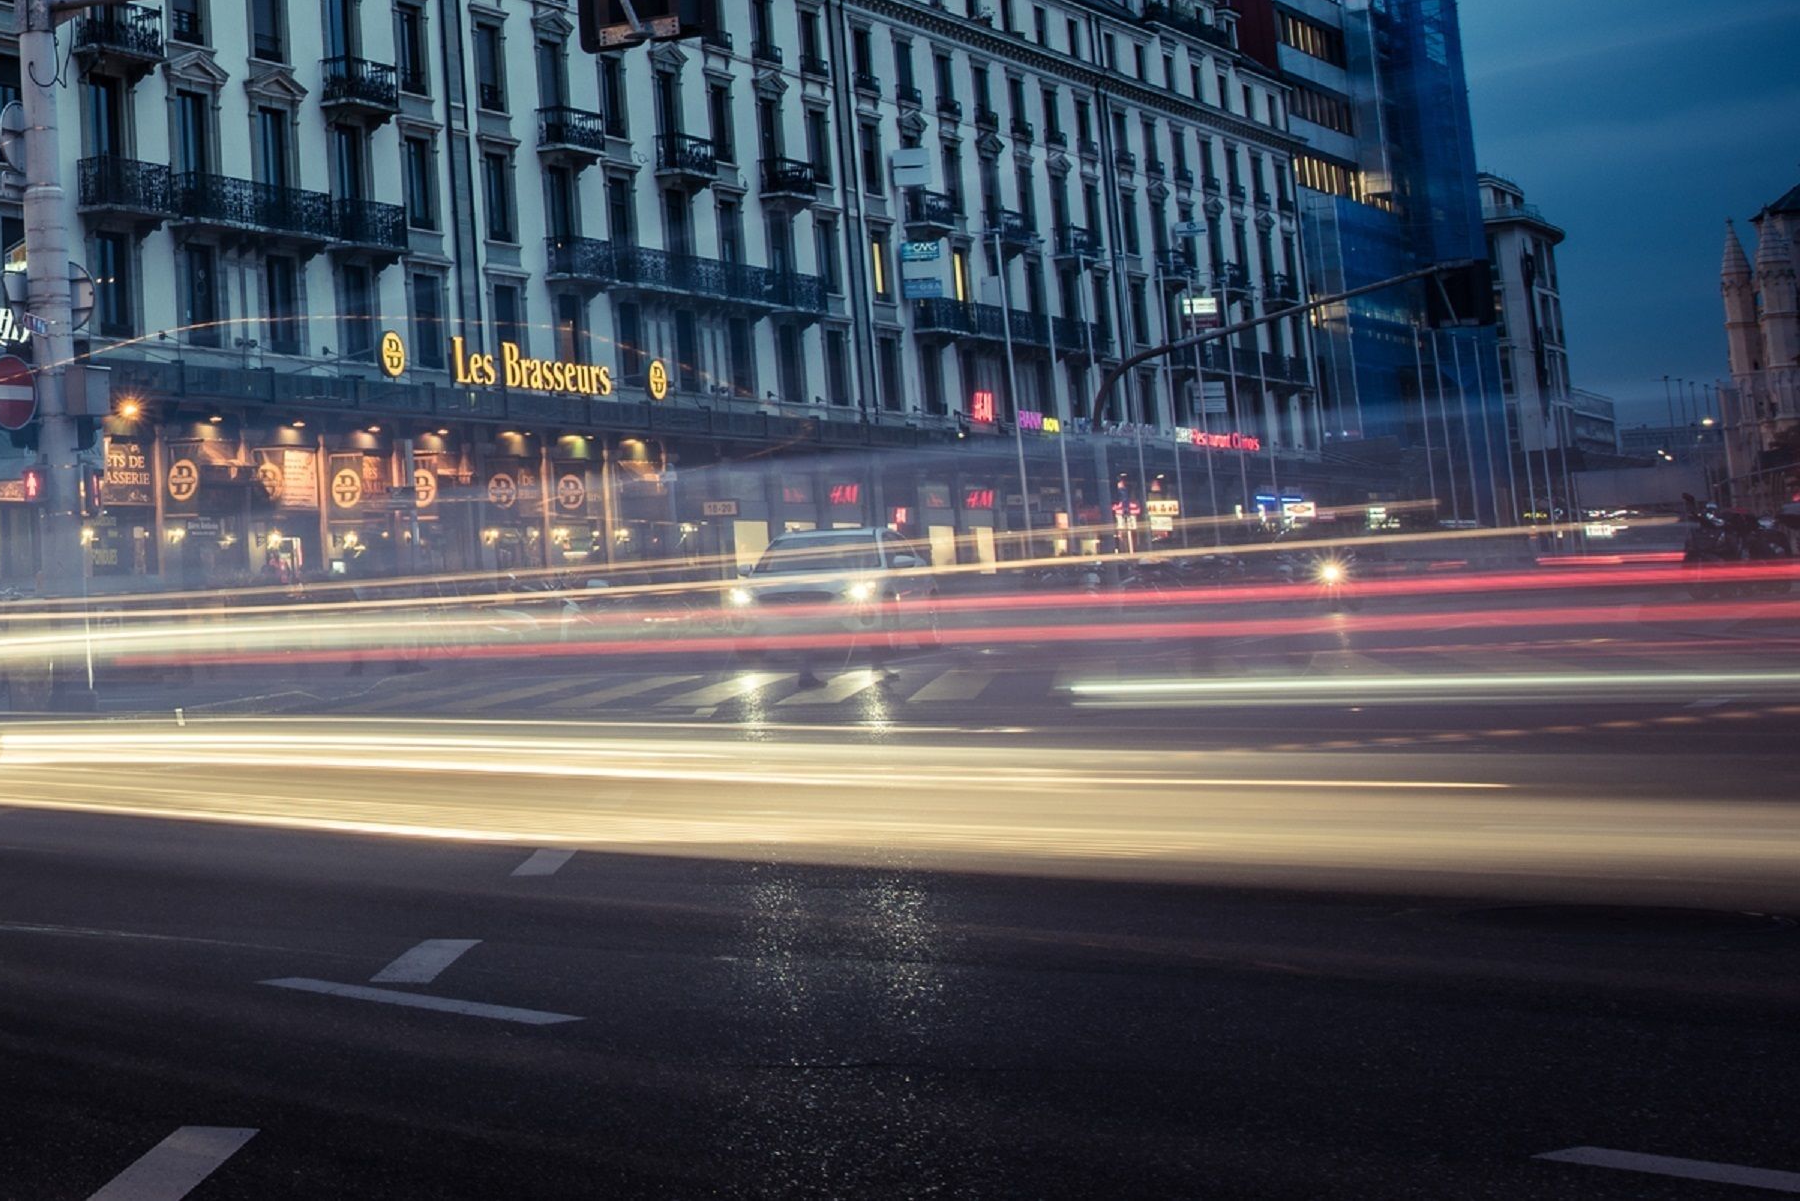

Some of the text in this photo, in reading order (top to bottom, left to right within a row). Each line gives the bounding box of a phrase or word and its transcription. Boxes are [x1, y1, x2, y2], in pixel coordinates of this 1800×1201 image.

[451, 336, 613, 396] Les Brasseurs
[1192, 428, 1231, 448] Resaurant
[128, 455, 145, 469] DE
